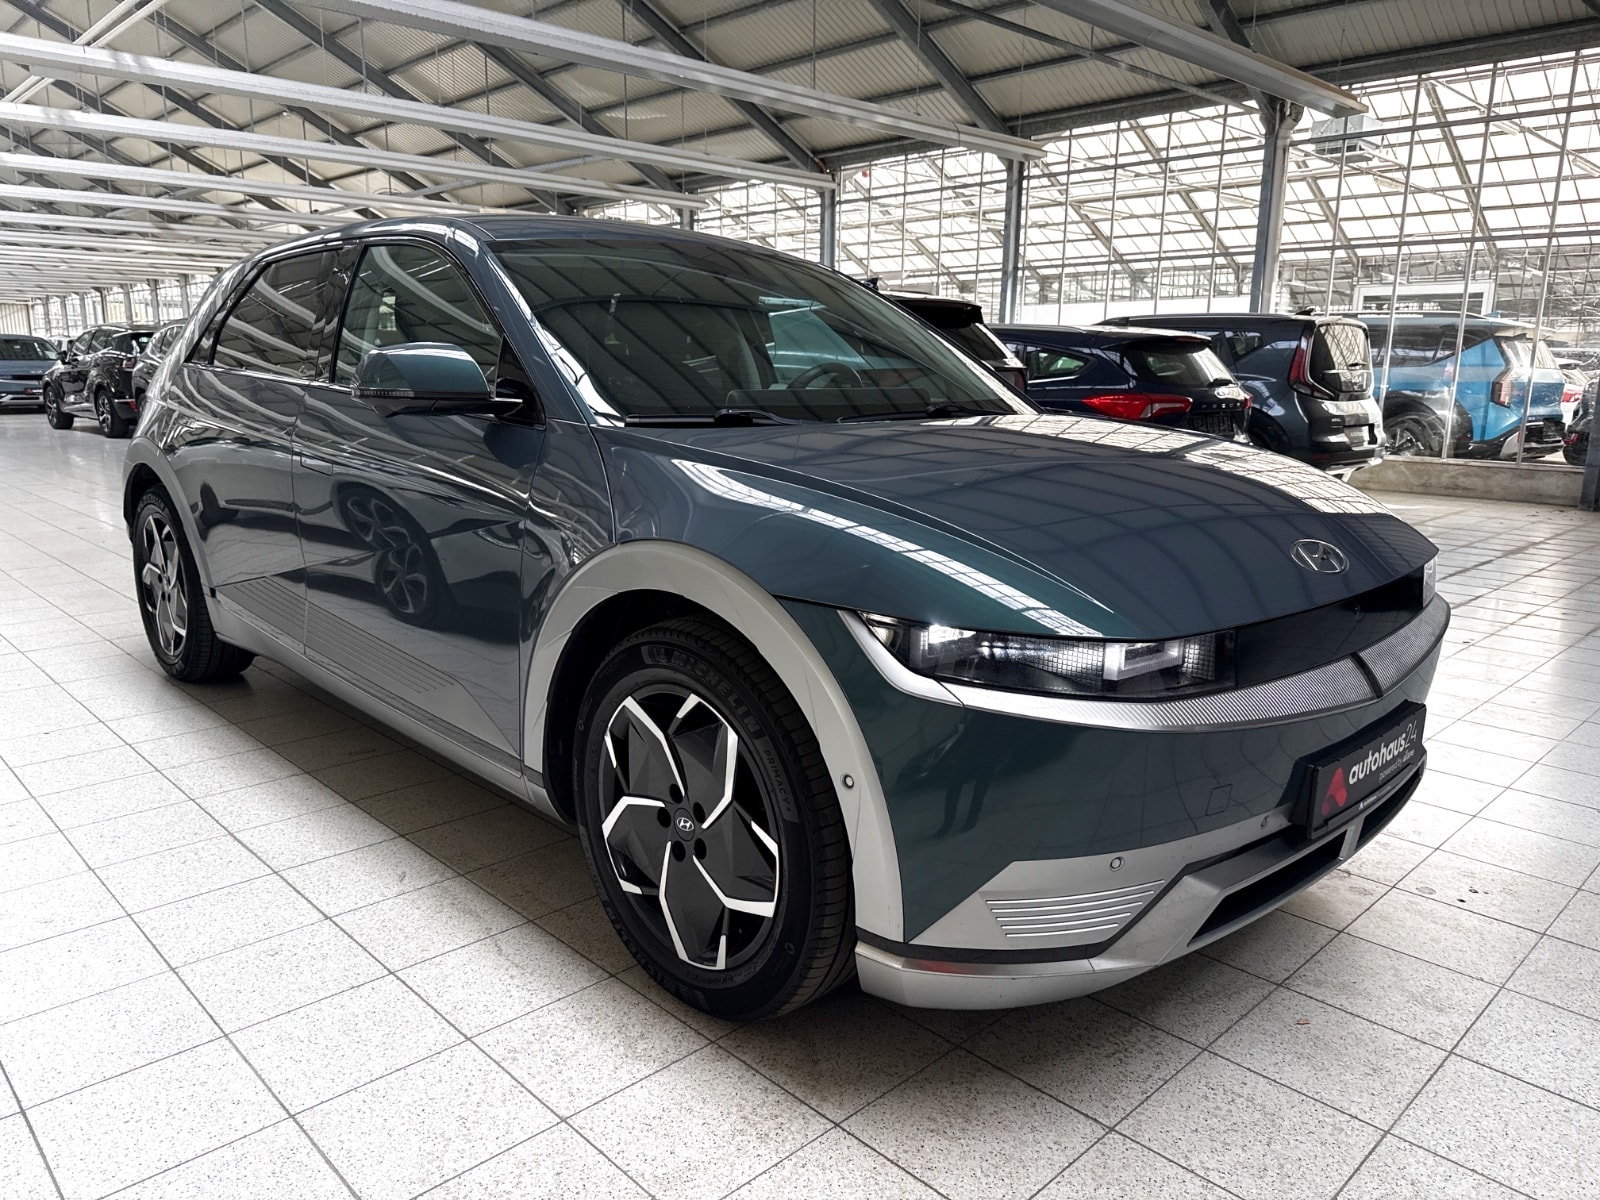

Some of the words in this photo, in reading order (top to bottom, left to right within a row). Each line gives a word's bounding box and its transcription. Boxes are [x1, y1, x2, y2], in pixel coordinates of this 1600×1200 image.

[669, 649, 761, 740] MICHELIN
[763, 748, 790, 806] PRIMACY
[1349, 720, 1417, 784] autohaus24
